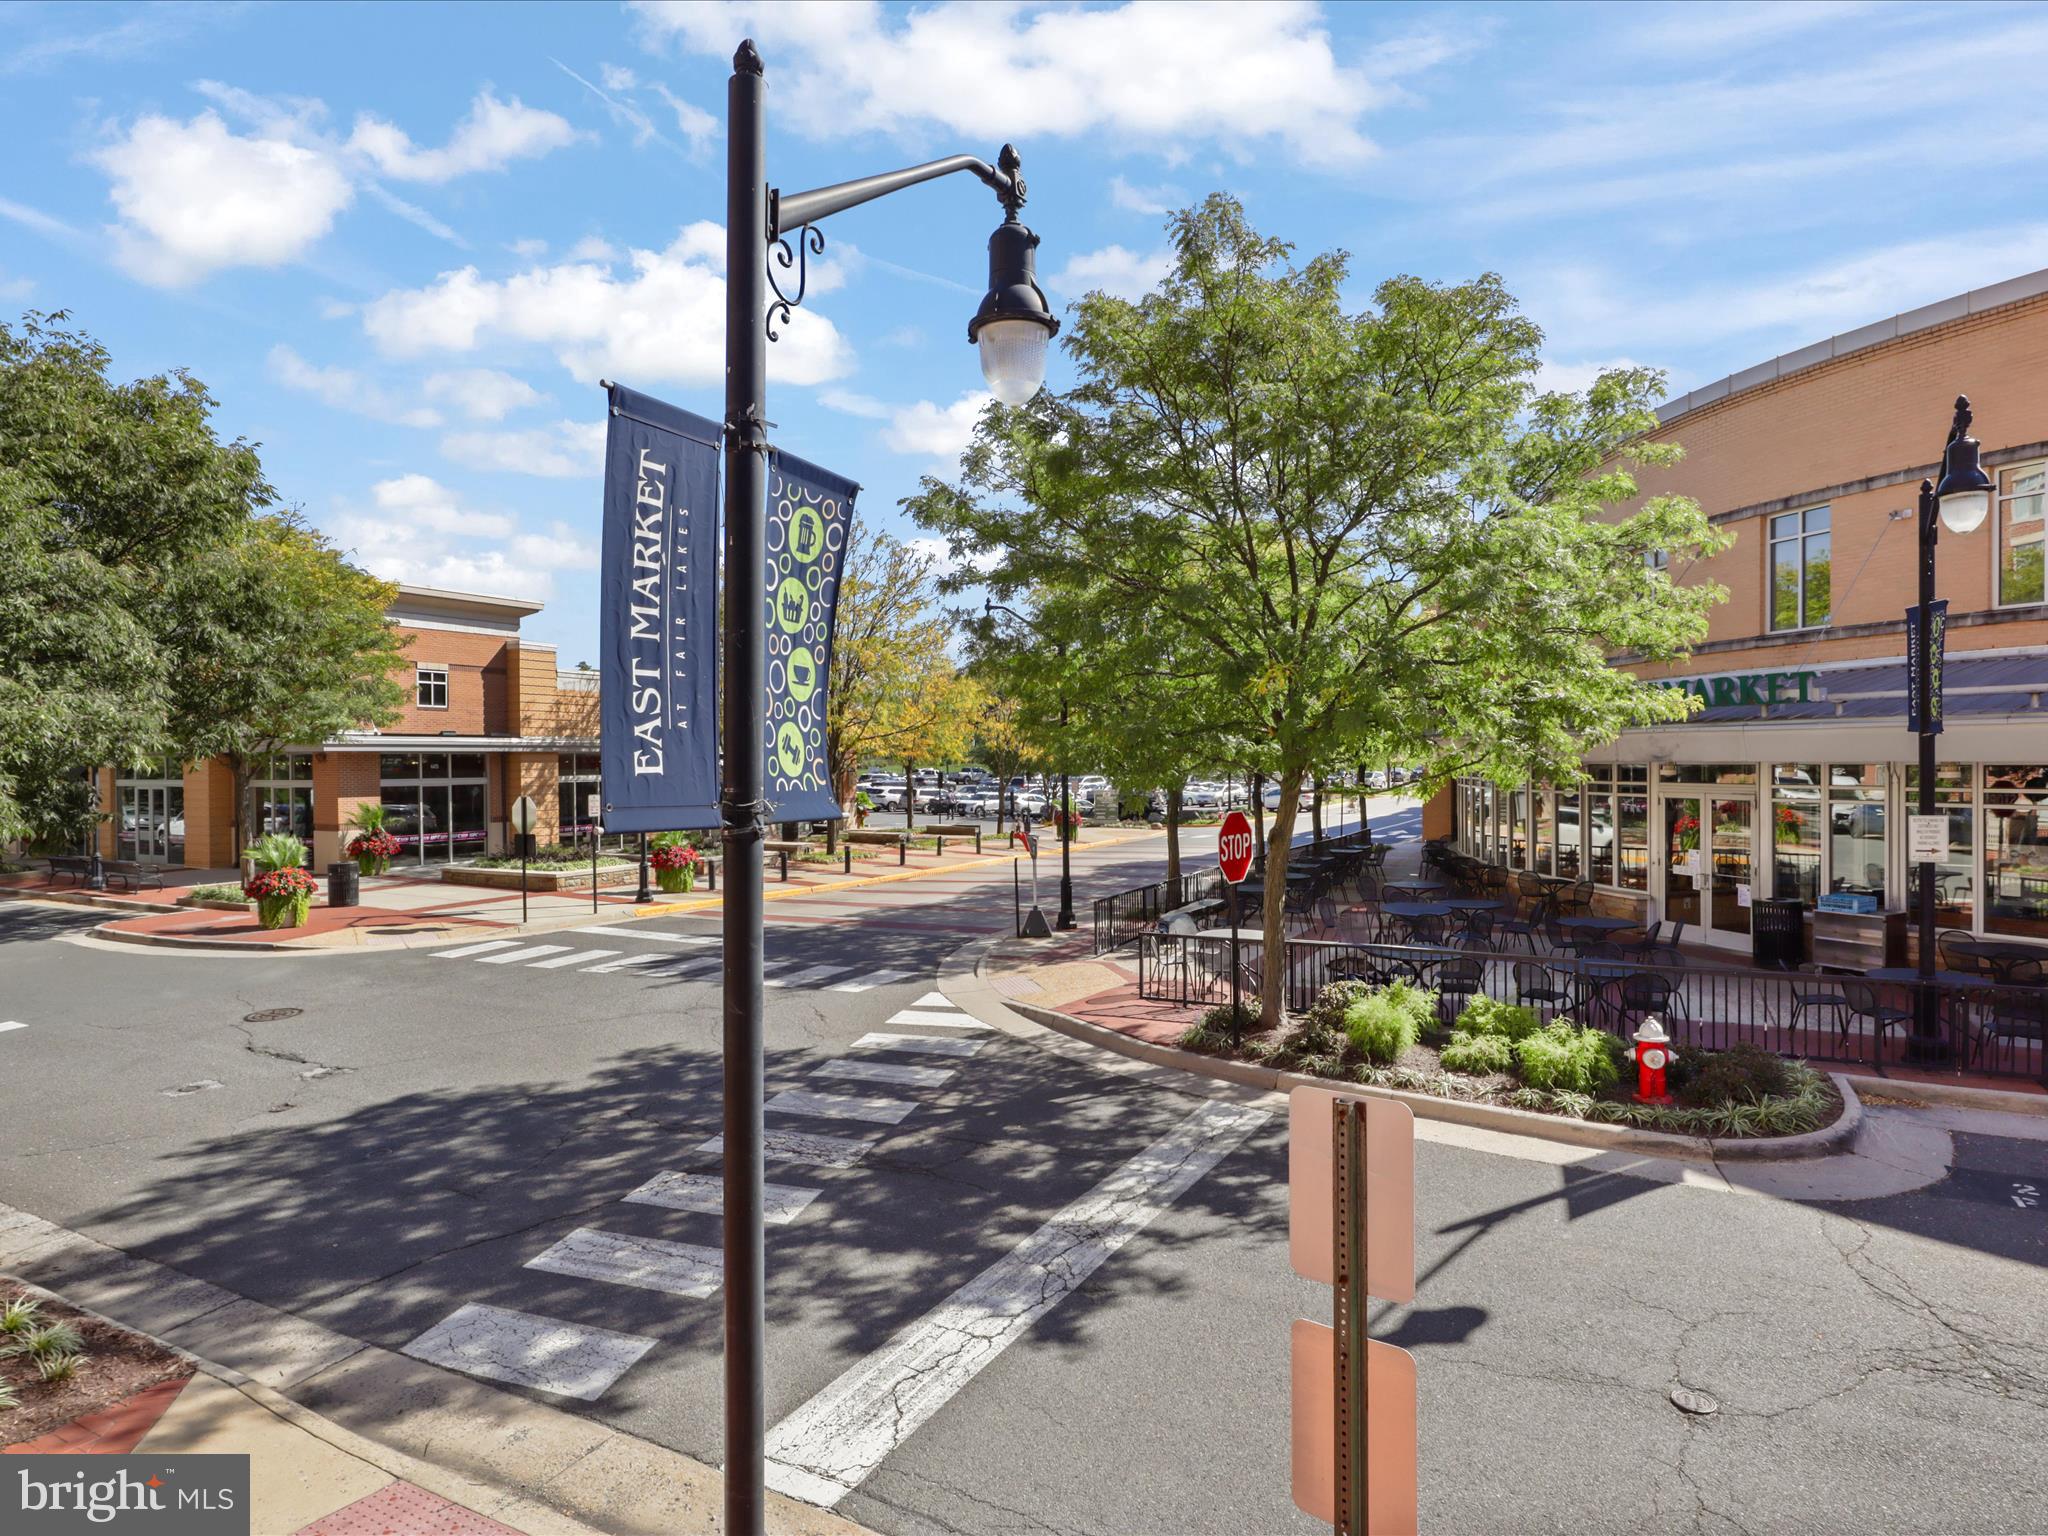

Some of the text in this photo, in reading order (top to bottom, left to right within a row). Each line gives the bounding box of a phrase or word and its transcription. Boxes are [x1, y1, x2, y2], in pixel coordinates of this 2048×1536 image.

[630, 448, 667, 776] EAST MARKET
[675, 508, 689, 729] AT FAIR LAKES
[1220, 832, 1250, 862] STOP
